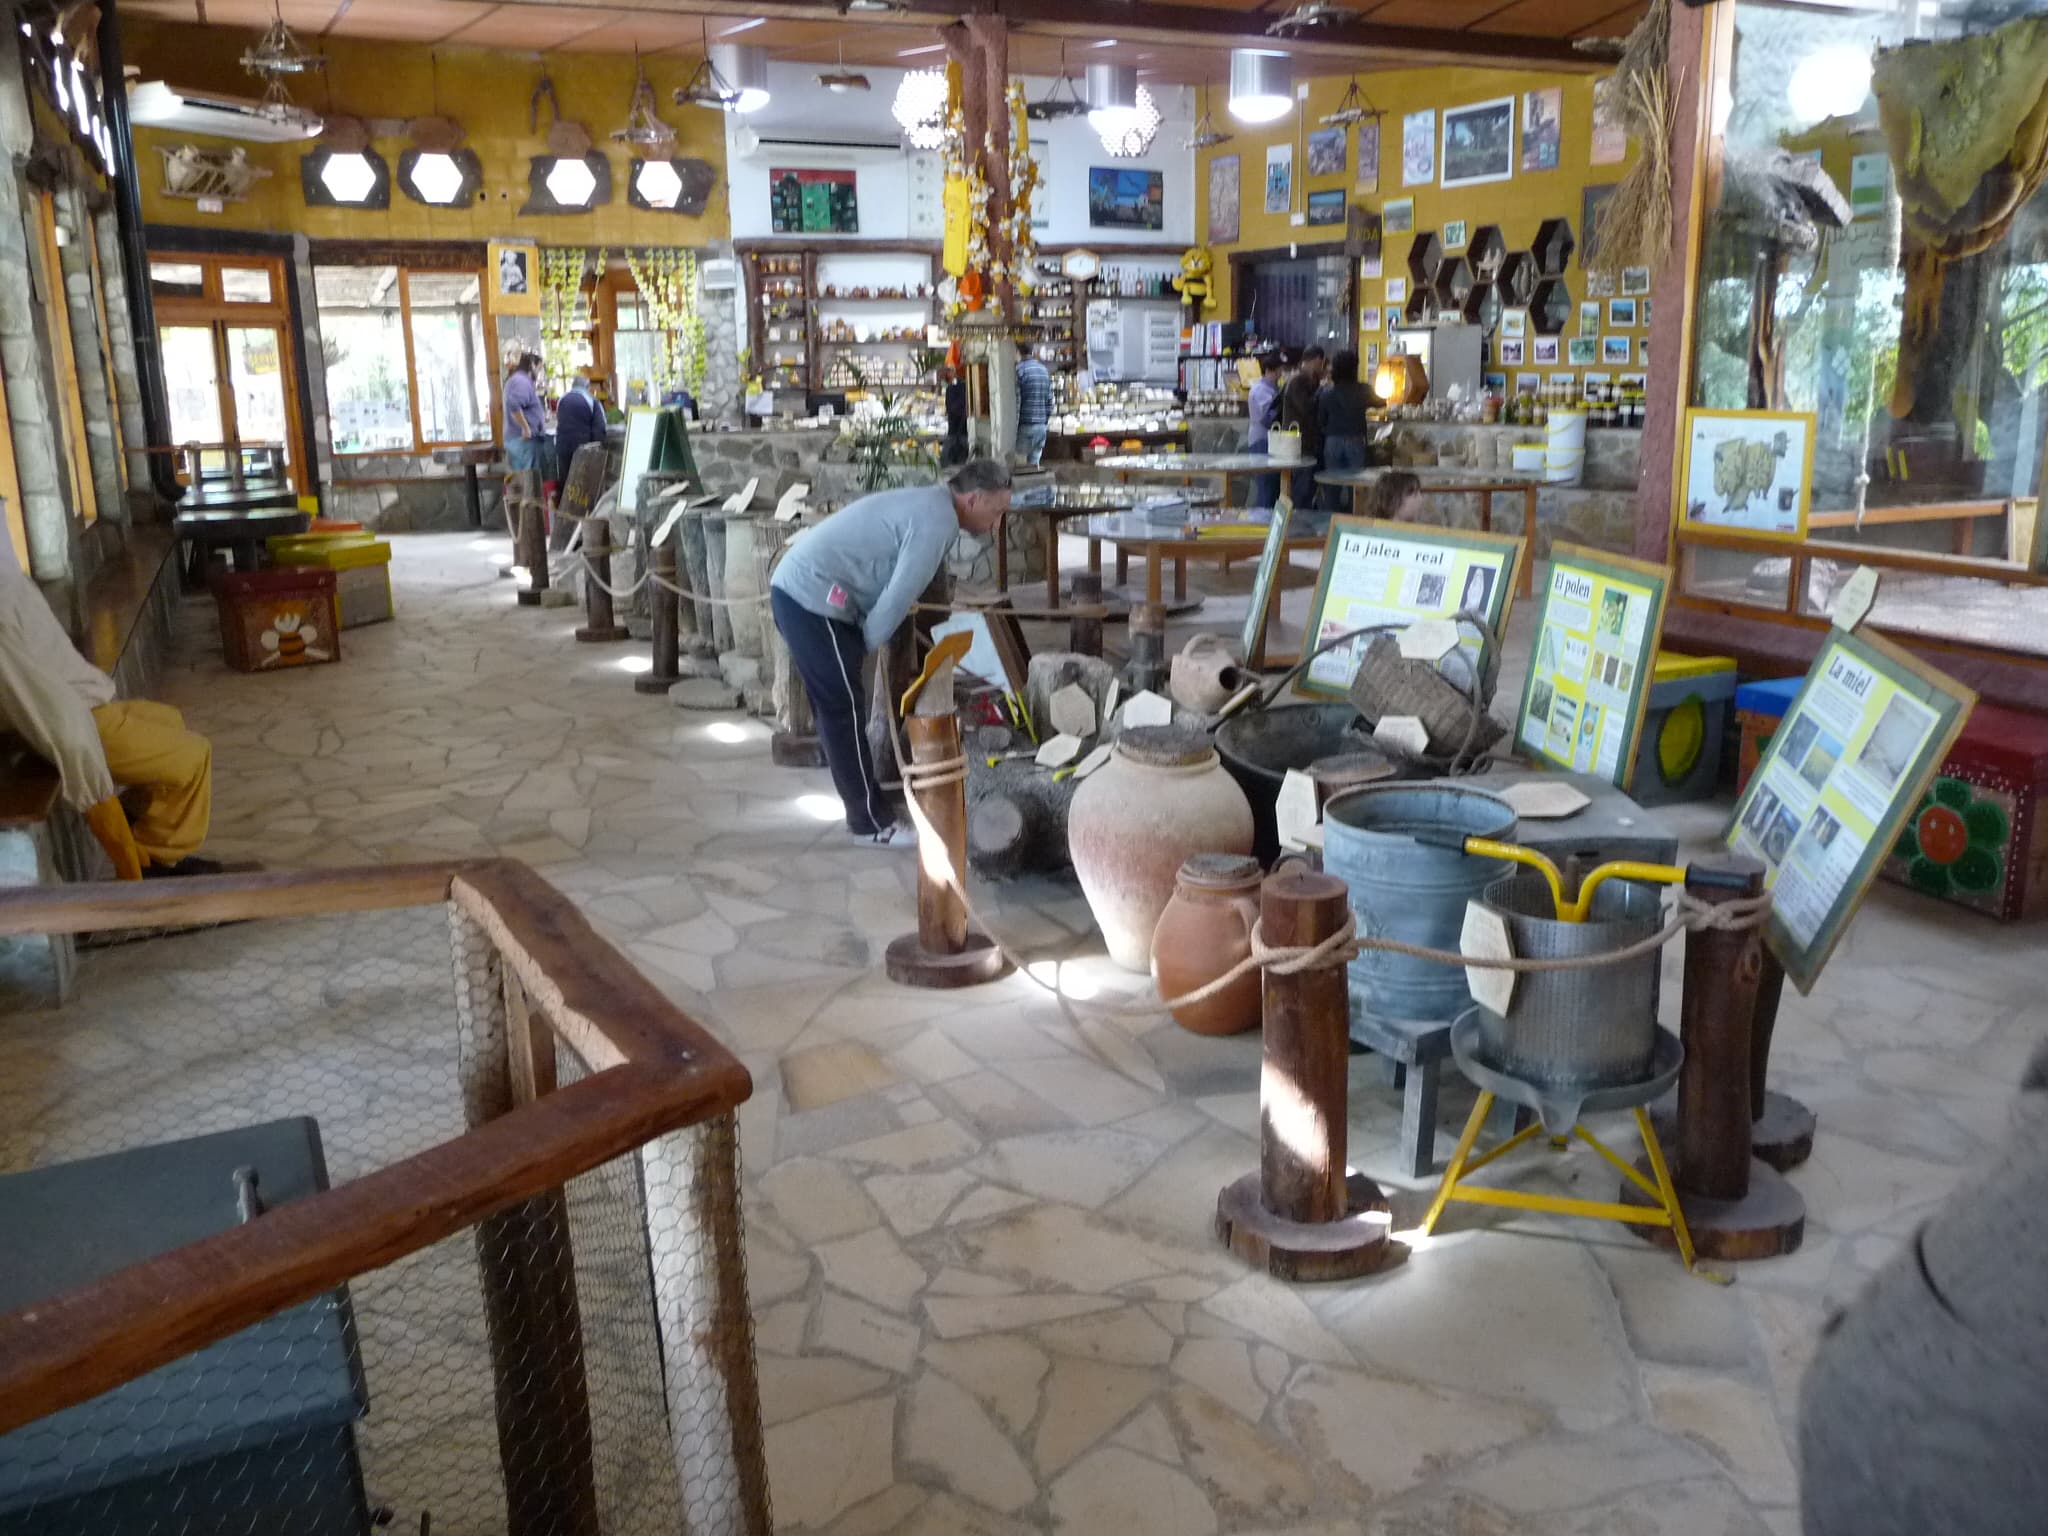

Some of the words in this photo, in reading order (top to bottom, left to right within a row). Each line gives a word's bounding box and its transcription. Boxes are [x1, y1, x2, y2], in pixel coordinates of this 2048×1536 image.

[1344, 539, 1360, 553] La
[1362, 540, 1400, 559] jalea
[1415, 551, 1444, 566] real
[1555, 572, 1565, 589] El
[1563, 577, 1590, 598] polen
[1828, 655, 1844, 680] La
[1841, 668, 1873, 697] miel
